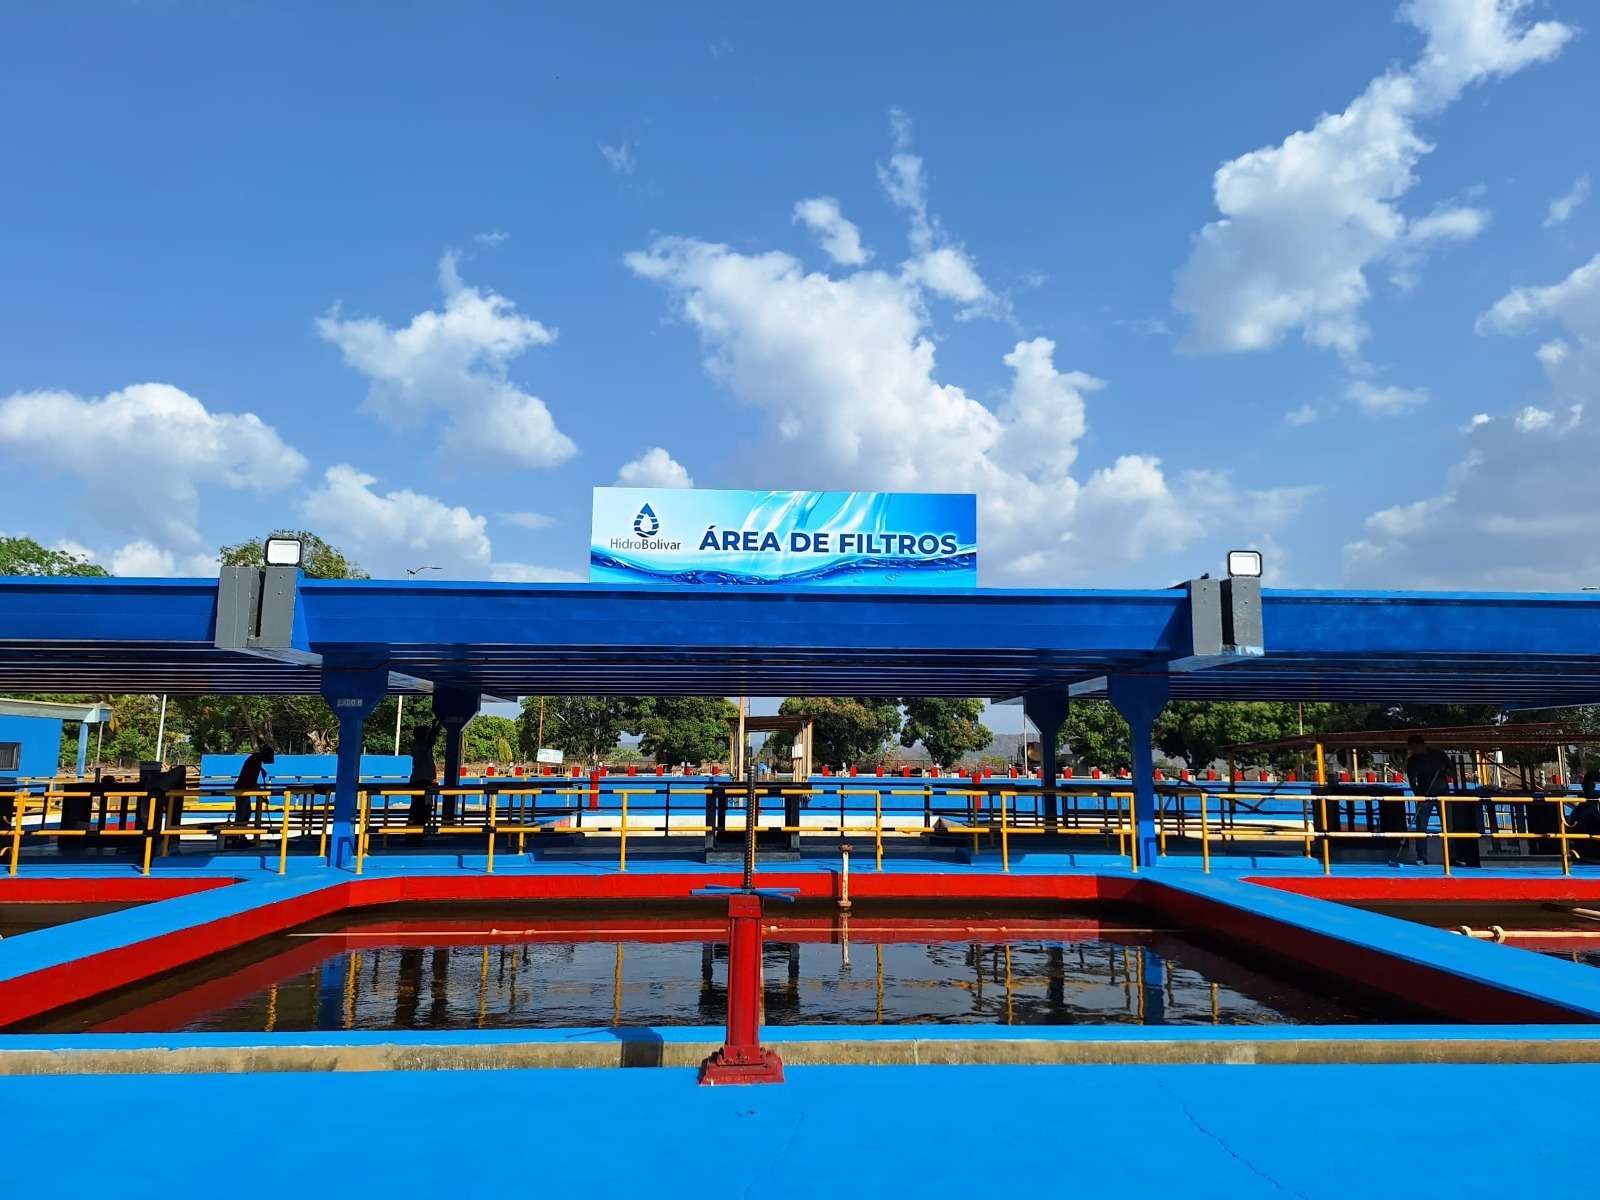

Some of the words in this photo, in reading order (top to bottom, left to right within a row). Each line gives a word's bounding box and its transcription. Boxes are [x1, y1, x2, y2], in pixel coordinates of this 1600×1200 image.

[699, 525, 781, 552] ÁREA
[790, 532, 829, 553] DE
[839, 533, 957, 555] FILTROS
